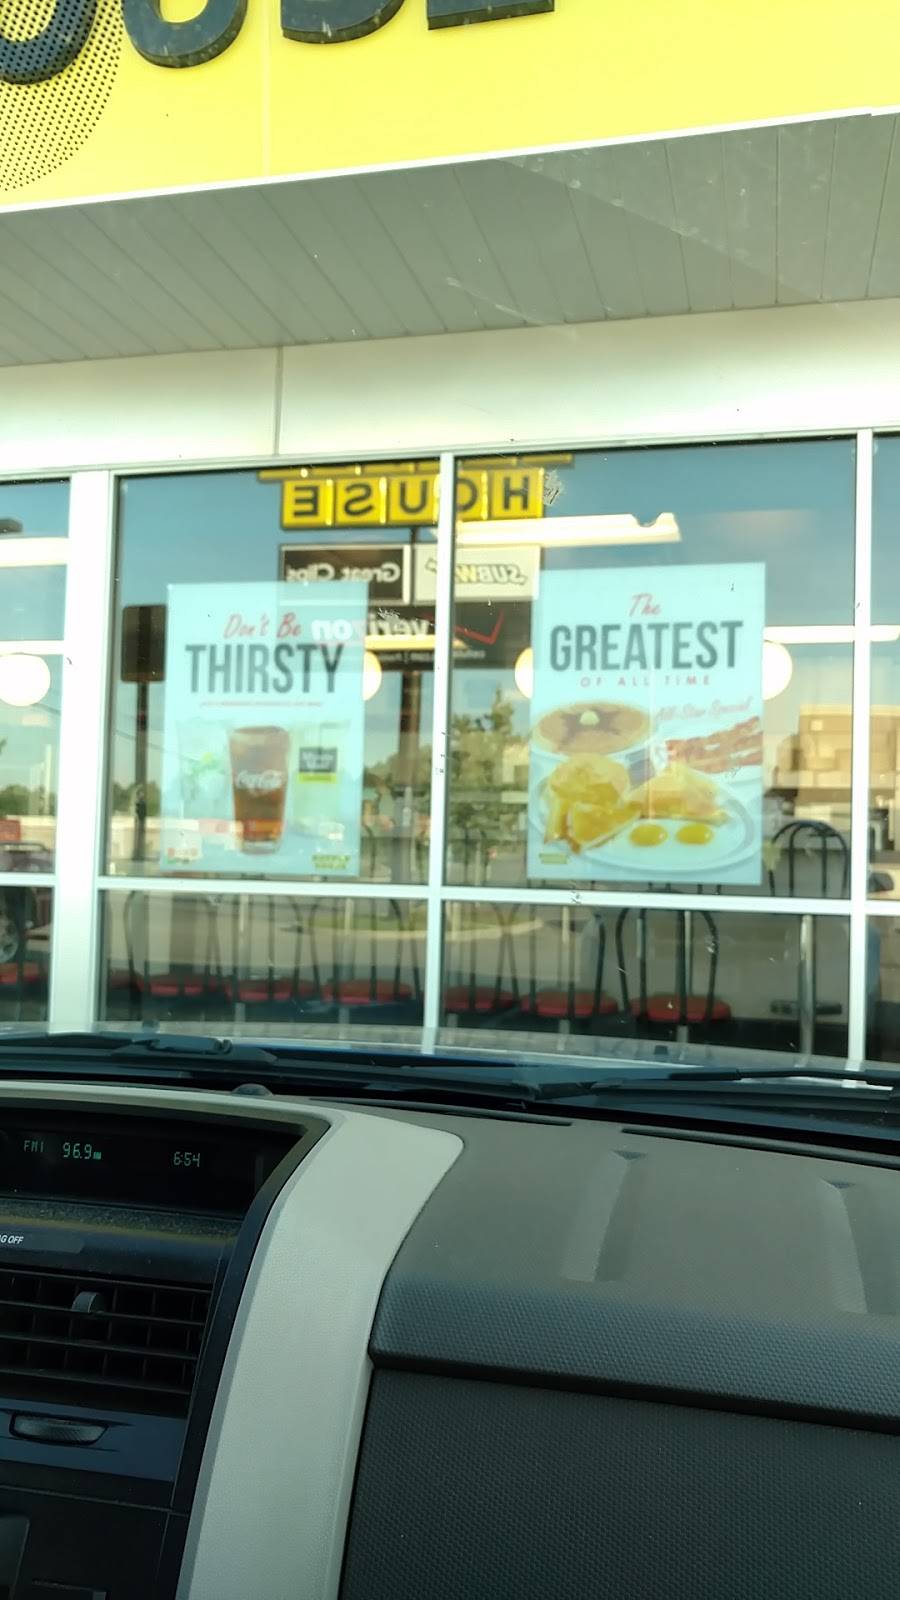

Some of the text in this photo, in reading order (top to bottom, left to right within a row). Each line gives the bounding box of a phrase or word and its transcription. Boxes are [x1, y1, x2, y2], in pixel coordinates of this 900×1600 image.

[629, 593, 661, 617] The
[224, 612, 302, 639] Don't Be
[550, 621, 743, 671] GREATEST
[185, 643, 344, 693] THIRSTY
[580, 675, 710, 688] OF ALL TIME
[62, 1142, 92, 1159] 96.9
[173, 1151, 201, 1167] 6:54
[8, 1235, 24, 1245] OFF
